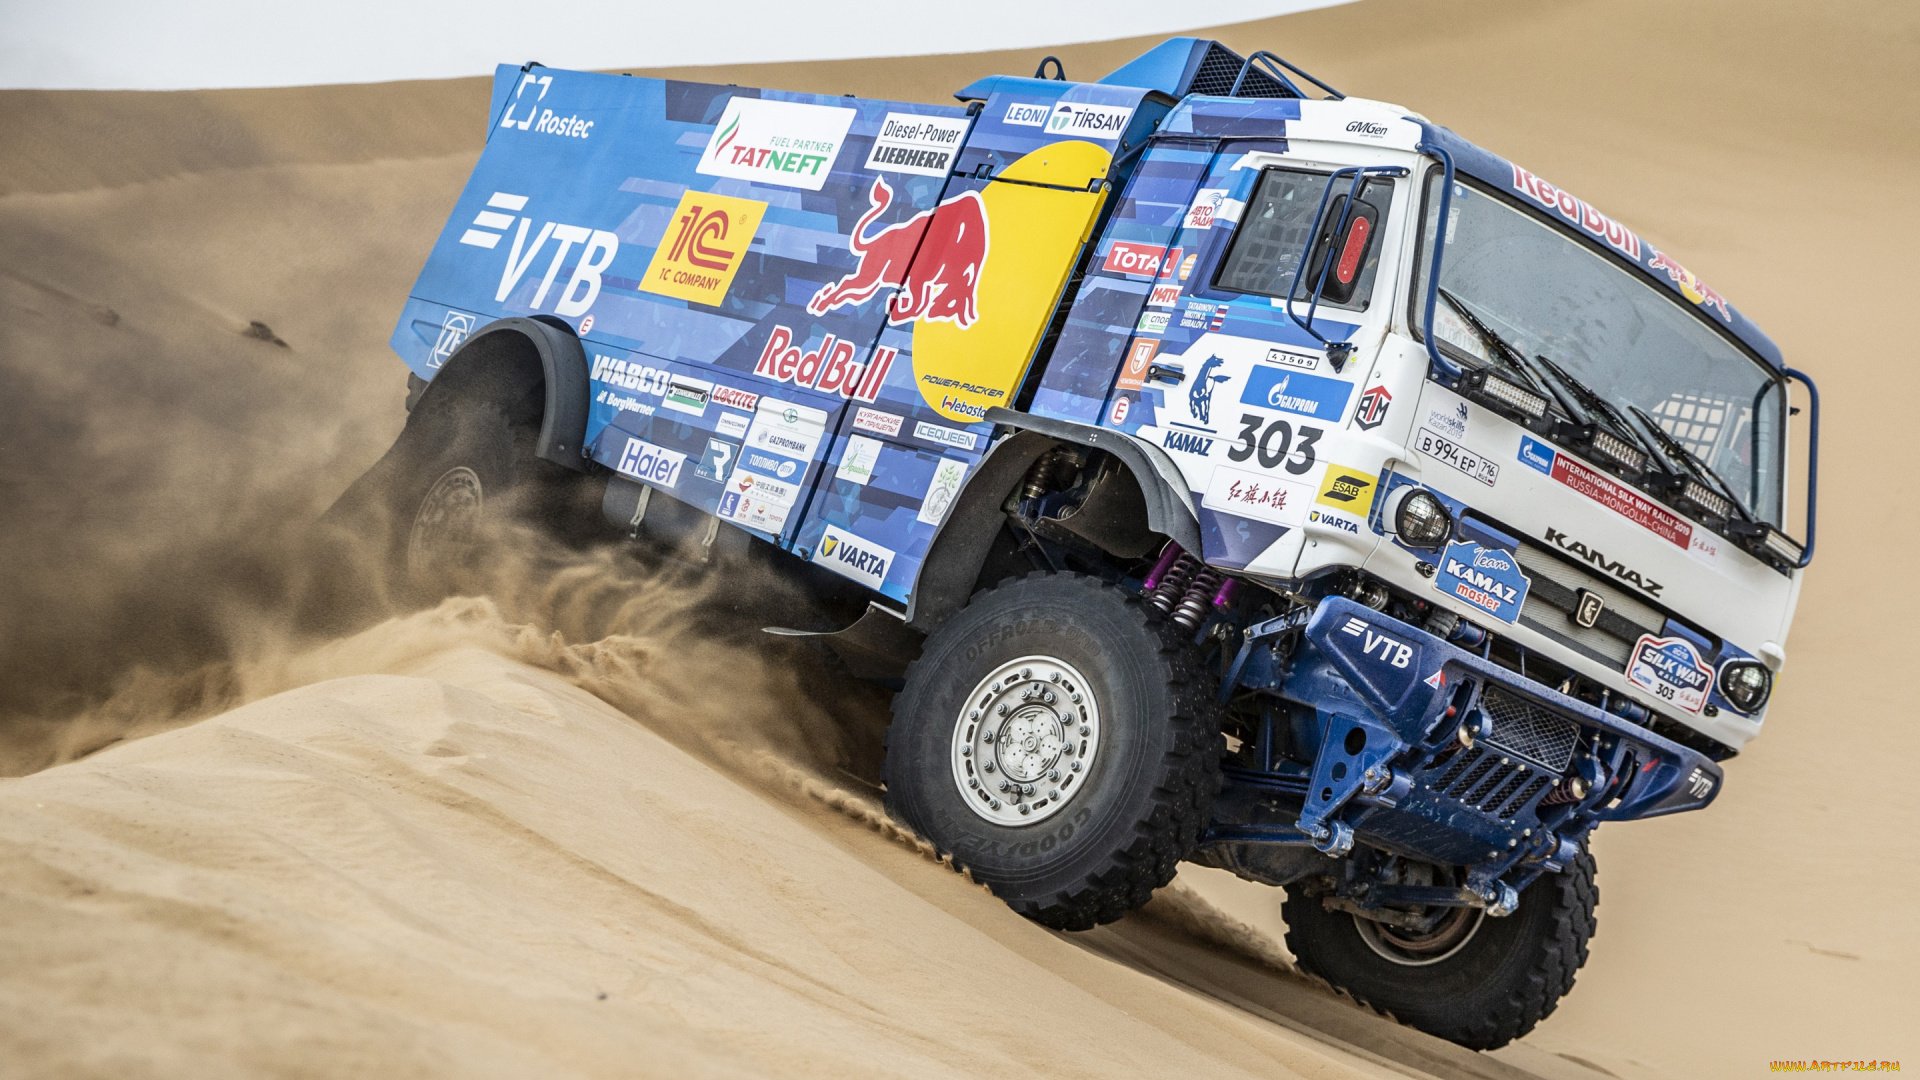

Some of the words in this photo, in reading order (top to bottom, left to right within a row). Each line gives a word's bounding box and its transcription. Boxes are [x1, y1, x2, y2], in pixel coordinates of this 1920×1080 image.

[535, 109, 594, 139] Rostec
[1006, 106, 1047, 123] LEONI
[884, 120, 961, 143] Diesel-Power
[1345, 121, 1388, 135] GMGen
[770, 136, 790, 148] FUEL
[792, 139, 833, 153] PARTNER
[730, 145, 827, 176] TATNEFT
[872, 146, 949, 170] LIEBHERR
[1189, 206, 1213, 216] АВТО
[1513, 163, 1580, 224] Red
[1581, 202, 1641, 262] Bull
[495, 217, 619, 318] VTB
[673, 271, 721, 291] COMPANY
[581, 319, 592, 333] E
[755, 325, 833, 388] Red
[816, 340, 897, 403] Bull
[1271, 353, 1313, 367] 43509
[590, 354, 671, 397] WABCO
[922, 374, 1004, 399] POWER-PACKER
[606, 392, 655, 416] BorgWarner
[713, 387, 756, 409] LOCTITE
[1280, 396, 1319, 414] GAZPROM
[857, 410, 900, 426] КУРГАНСКИЕ
[1114, 403, 1127, 420] E
[1431, 410, 1465, 432] worldskills
[864, 420, 897, 433] ПРИЦЕПЫ
[916, 425, 975, 446] ICEQUEEN
[1428, 417, 1448, 433] Kazan
[1446, 426, 1463, 439] 2019
[768, 435, 807, 452] GAZPROMBANK
[1163, 430, 1214, 457] KAMAZ
[1228, 413, 1324, 476] 303
[1434, 440, 1459, 465] 994
[621, 442, 679, 483] Haier
[1228, 480, 1288, 510] 红旗小镇
[1332, 481, 1360, 498] ESAB
[1556, 456, 1617, 496] INTERNATIONAL
[1617, 487, 1635, 505] SILK
[1635, 496, 1653, 515] WAY
[1651, 508, 1677, 527] RALLY
[1674, 520, 1691, 536] 2019
[1321, 513, 1358, 535] VARTA
[838, 541, 886, 579] VARTA
[1473, 547, 1511, 571] Team
[1543, 526, 1664, 599] KAMAZ
[1446, 558, 1520, 605] KAMAZ
[1456, 582, 1501, 612] master
[1363, 630, 1414, 669] VTB
[1641, 648, 1678, 674] SILK
[1675, 664, 1706, 687] WAY
[1657, 670, 1685, 686] RALLY
[1656, 683, 1675, 700] 303
[1689, 774, 1714, 799] VTB
